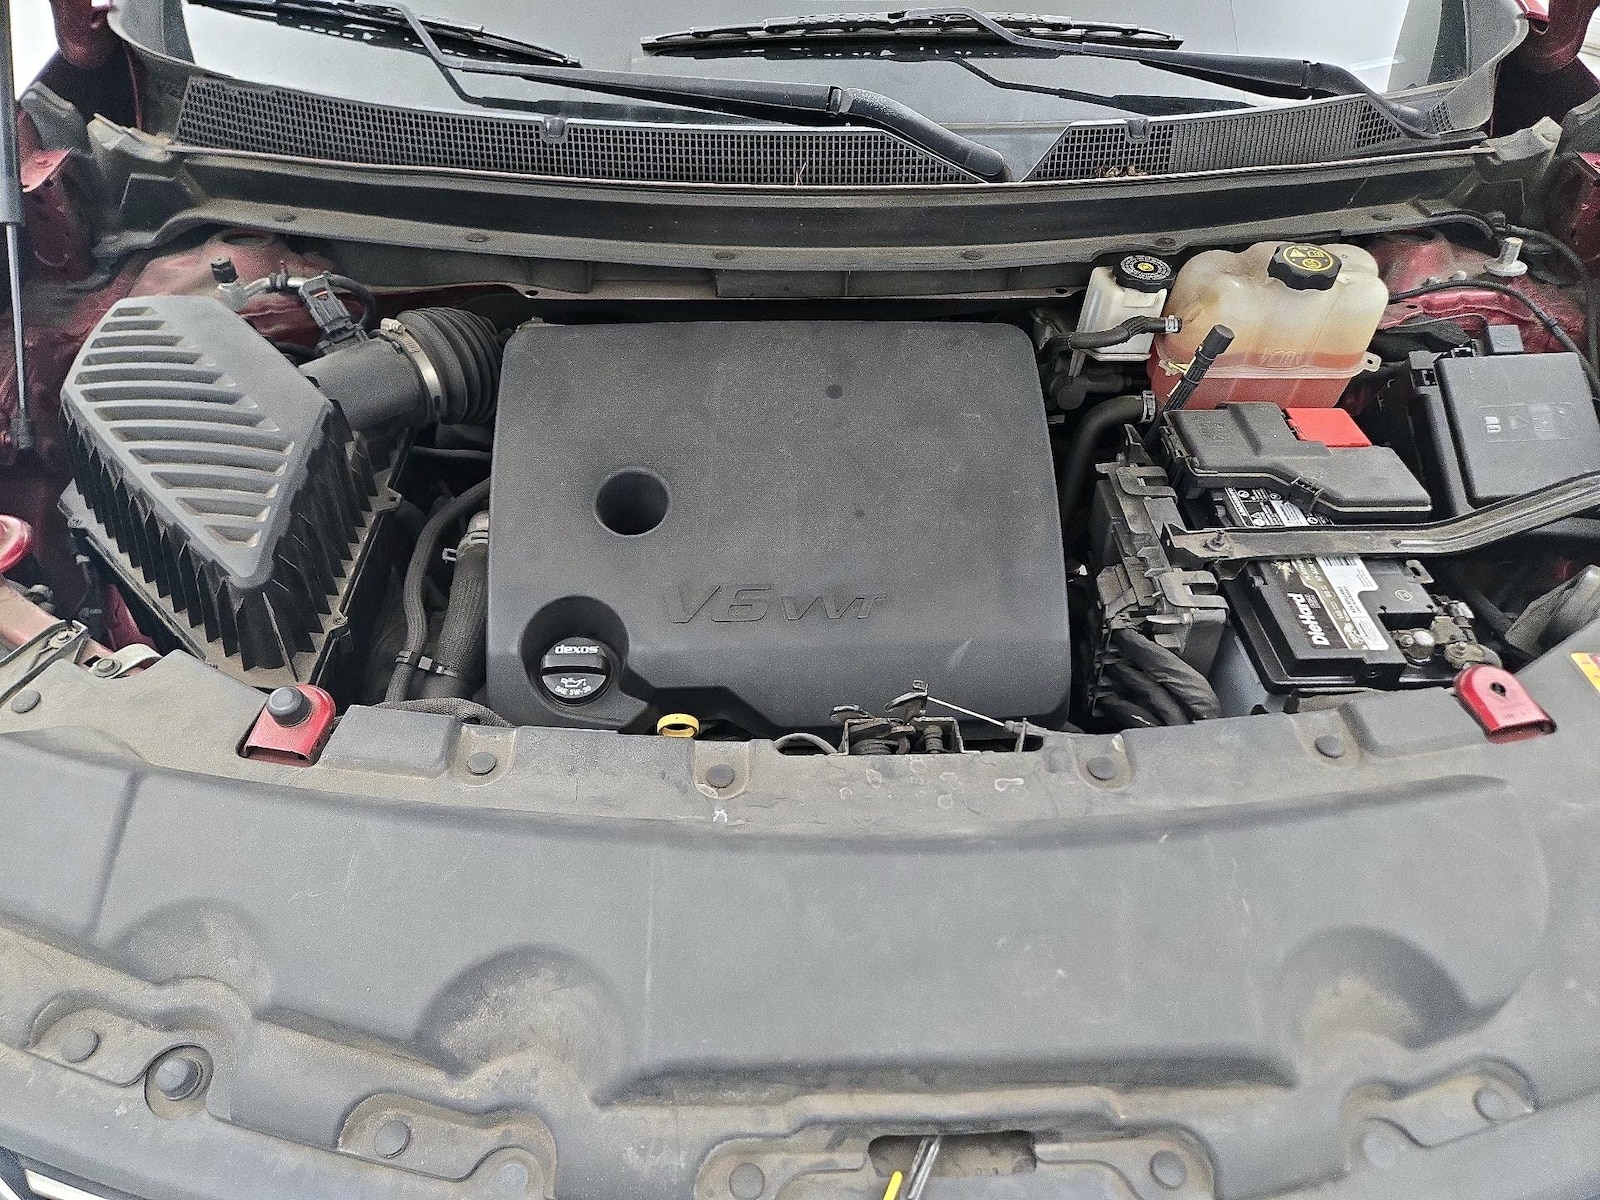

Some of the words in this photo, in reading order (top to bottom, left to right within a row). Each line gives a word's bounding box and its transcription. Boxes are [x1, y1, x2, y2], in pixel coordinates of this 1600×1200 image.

[662, 584, 772, 624] V6
[780, 594, 886, 621] VVT
[1287, 593, 1330, 645] DieHard
[554, 644, 600, 654] dexos
[555, 685, 568, 695] SAE
[569, 685, 592, 696] 5W-30
